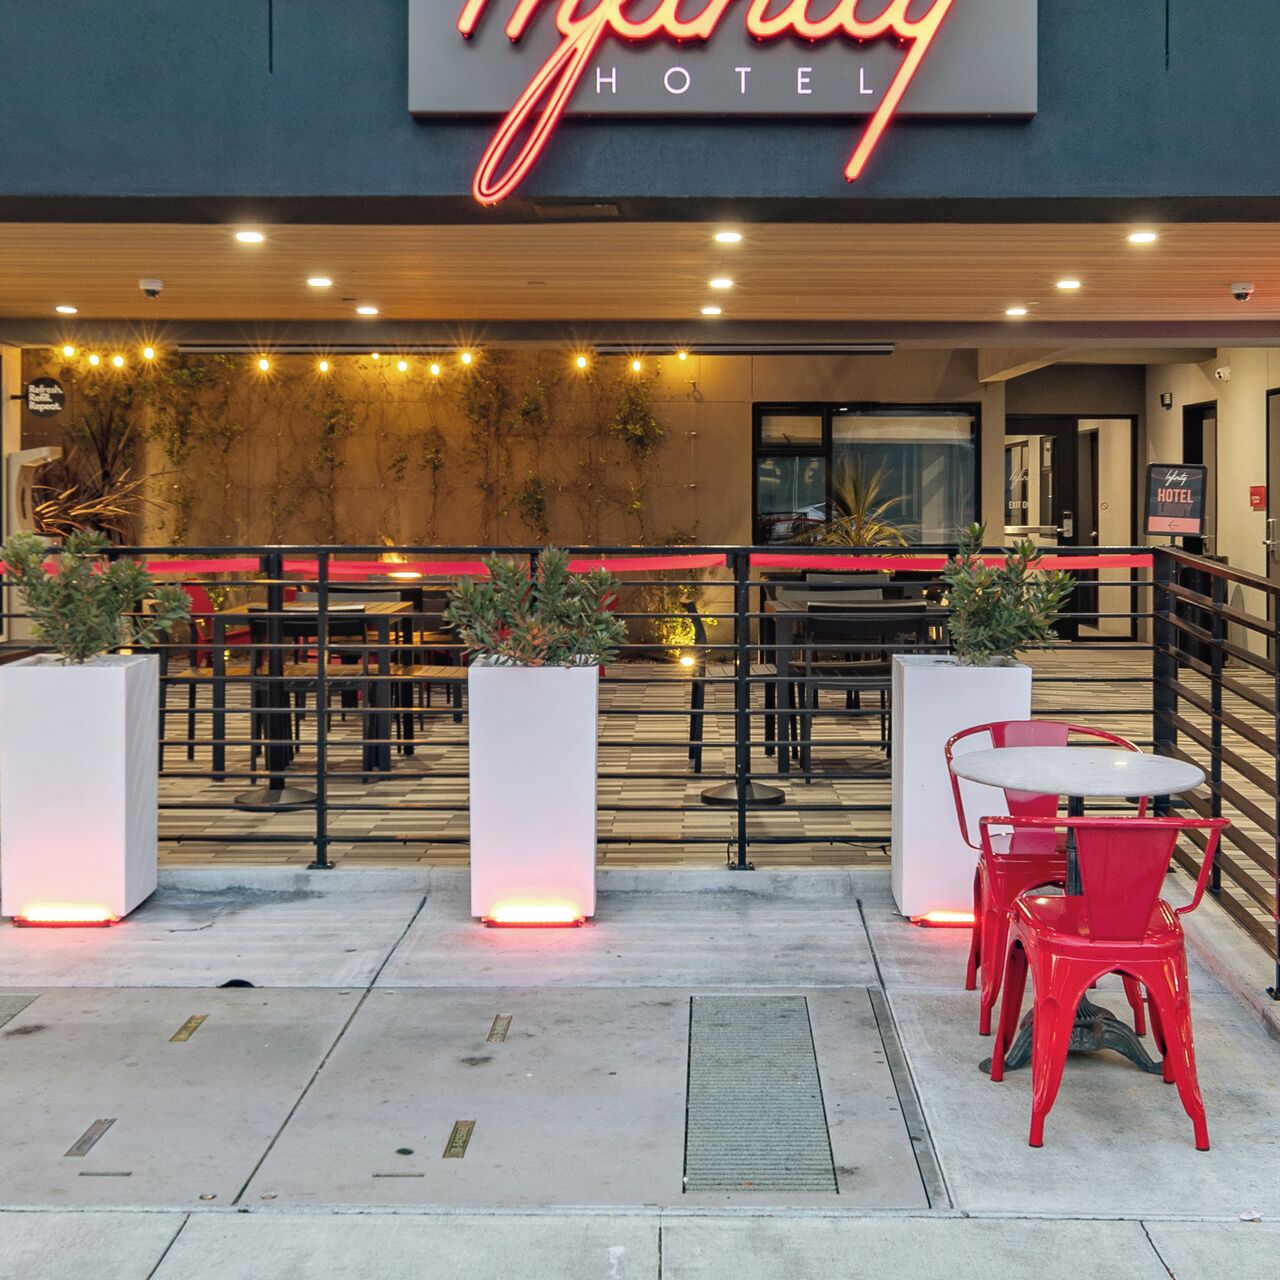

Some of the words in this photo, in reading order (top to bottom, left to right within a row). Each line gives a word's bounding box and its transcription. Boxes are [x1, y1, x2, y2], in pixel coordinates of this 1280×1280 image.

[596, 66, 873, 95] HOTEL
[28, 384, 64, 394] Refresh.
[28, 393, 53, 402] Refill.
[28, 402, 63, 412] Repeat.
[1165, 469, 1189, 487] Infinity
[1157, 488, 1194, 504] HOTEL
